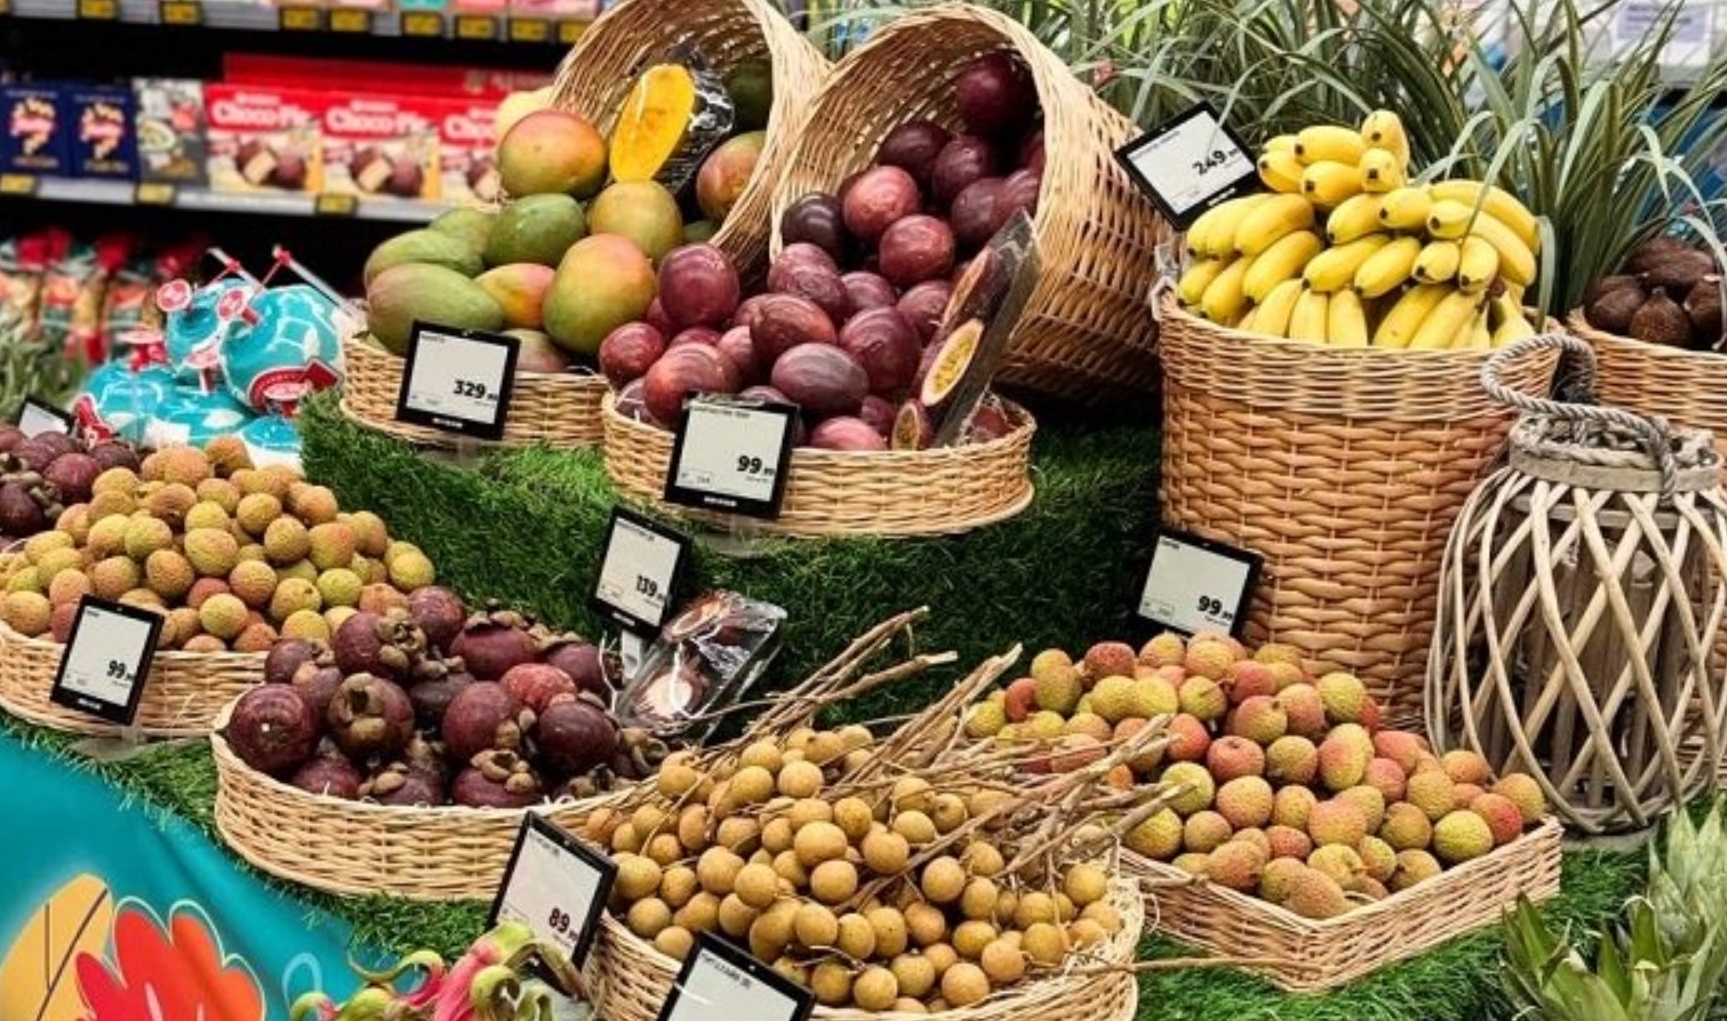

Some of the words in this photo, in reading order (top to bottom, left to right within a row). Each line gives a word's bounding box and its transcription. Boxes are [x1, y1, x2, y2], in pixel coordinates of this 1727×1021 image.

[211, 98, 278, 126] Choco
[326, 107, 394, 135] Choco
[1192, 150, 1226, 176] 249
[454, 380, 485, 399] 329
[737, 455, 762, 474] 99
[636, 574, 658, 598] 139
[1198, 595, 1222, 615] 99
[107, 660, 126, 679] 99
[549, 907, 570, 933] 89
